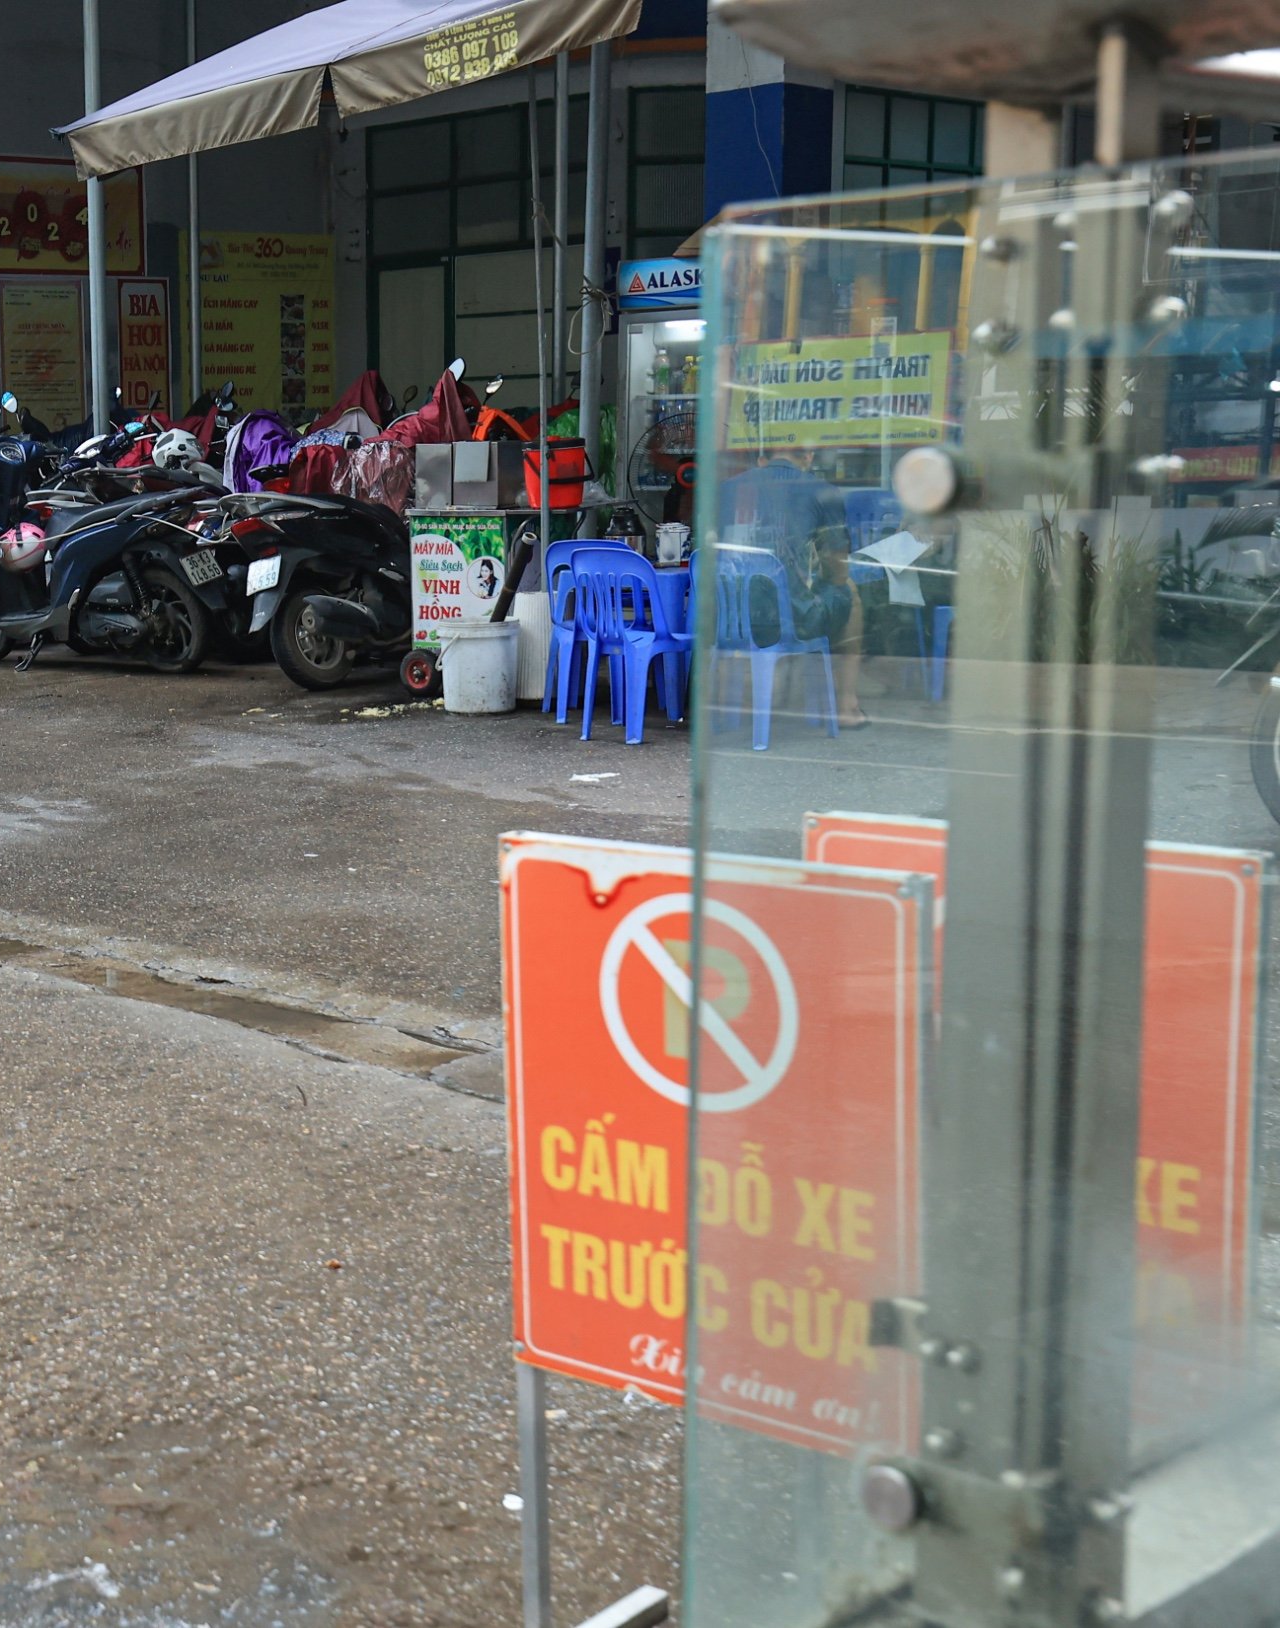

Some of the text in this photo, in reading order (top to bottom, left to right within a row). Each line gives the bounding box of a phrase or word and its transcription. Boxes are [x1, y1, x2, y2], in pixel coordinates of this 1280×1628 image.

[424, 36, 451, 51] CHẤT
[454, 28, 490, 42] LƯỢNG
[493, 21, 515, 32] CAO
[424, 30, 518, 70] 0386 097 108
[255, 237, 284, 258] 360
[129, 294, 160, 316] BIA
[128, 325, 162, 347] HƠI
[123, 355, 141, 371] HÀ
[414, 540, 454, 555] MÁY MÍA
[440, 559, 463, 573] Sạch
[540, 1113, 876, 1262] CẤM ĐỖ XE
[540, 1223, 878, 1374] TRƯỚC CỬA
[629, 1333, 705, 1386] Xin
